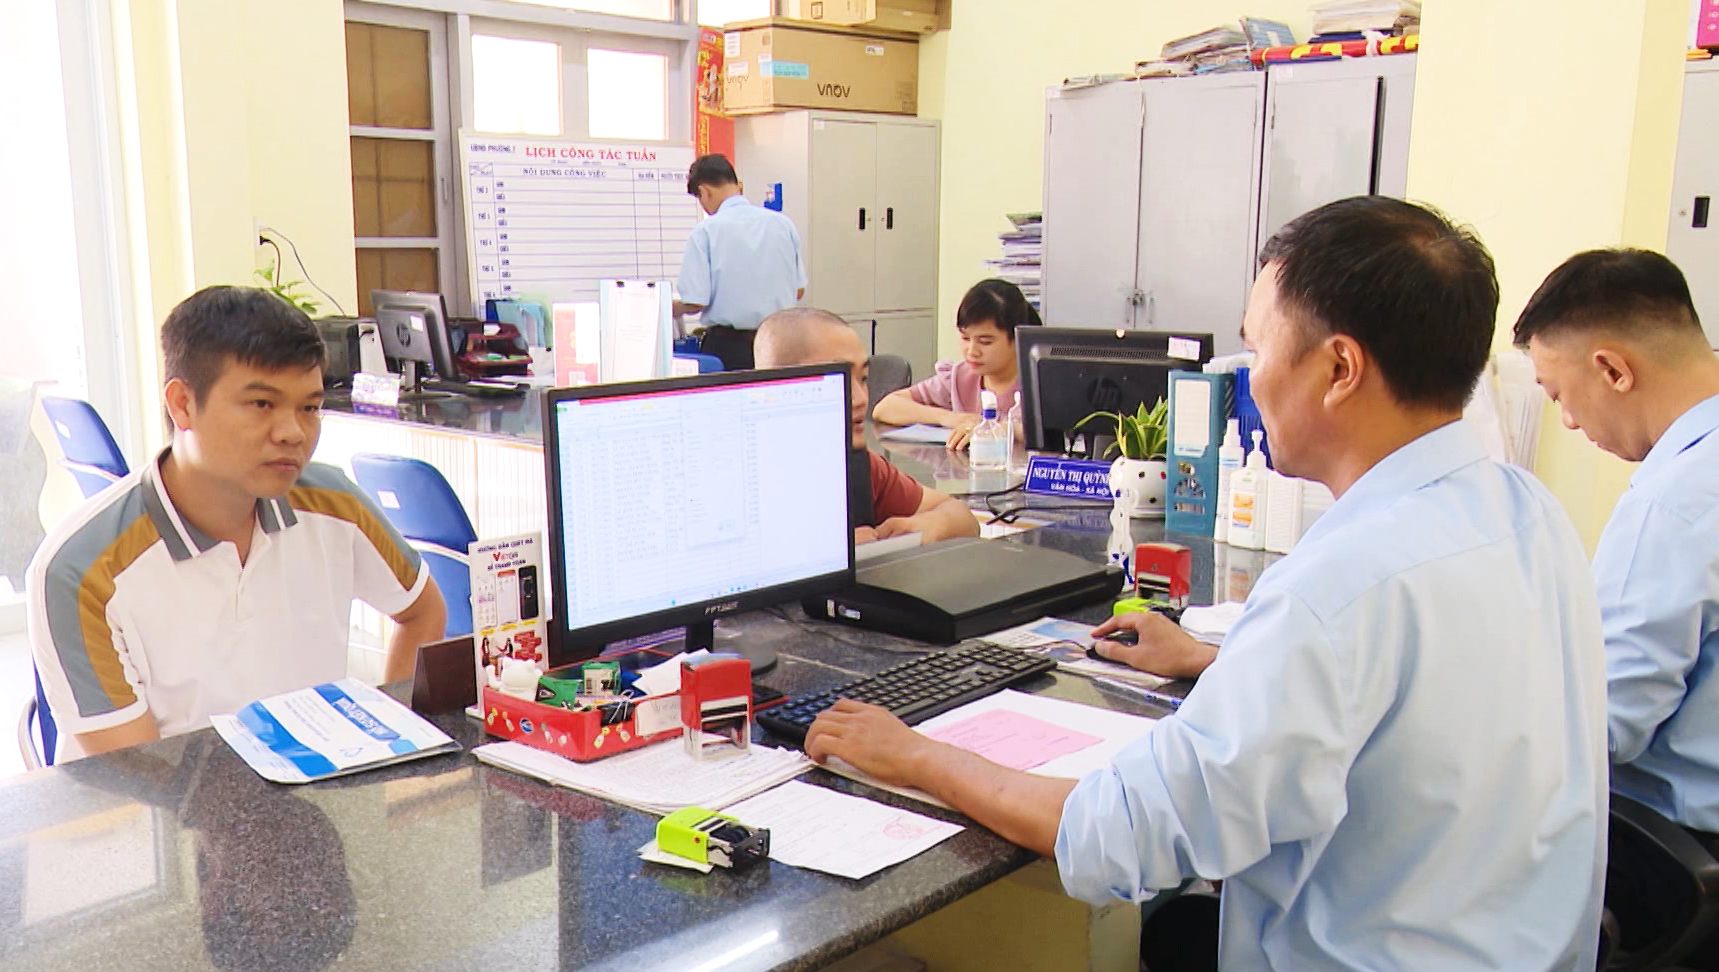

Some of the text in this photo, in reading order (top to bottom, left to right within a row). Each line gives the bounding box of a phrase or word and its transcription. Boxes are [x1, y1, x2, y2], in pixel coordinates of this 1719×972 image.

[526, 147, 556, 159] LỊCH
[560, 147, 594, 159] CÔNG
[599, 147, 622, 160] TÁC
[1032, 467, 1067, 480] NGUYỄN
[1067, 471, 1082, 484] THỊ
